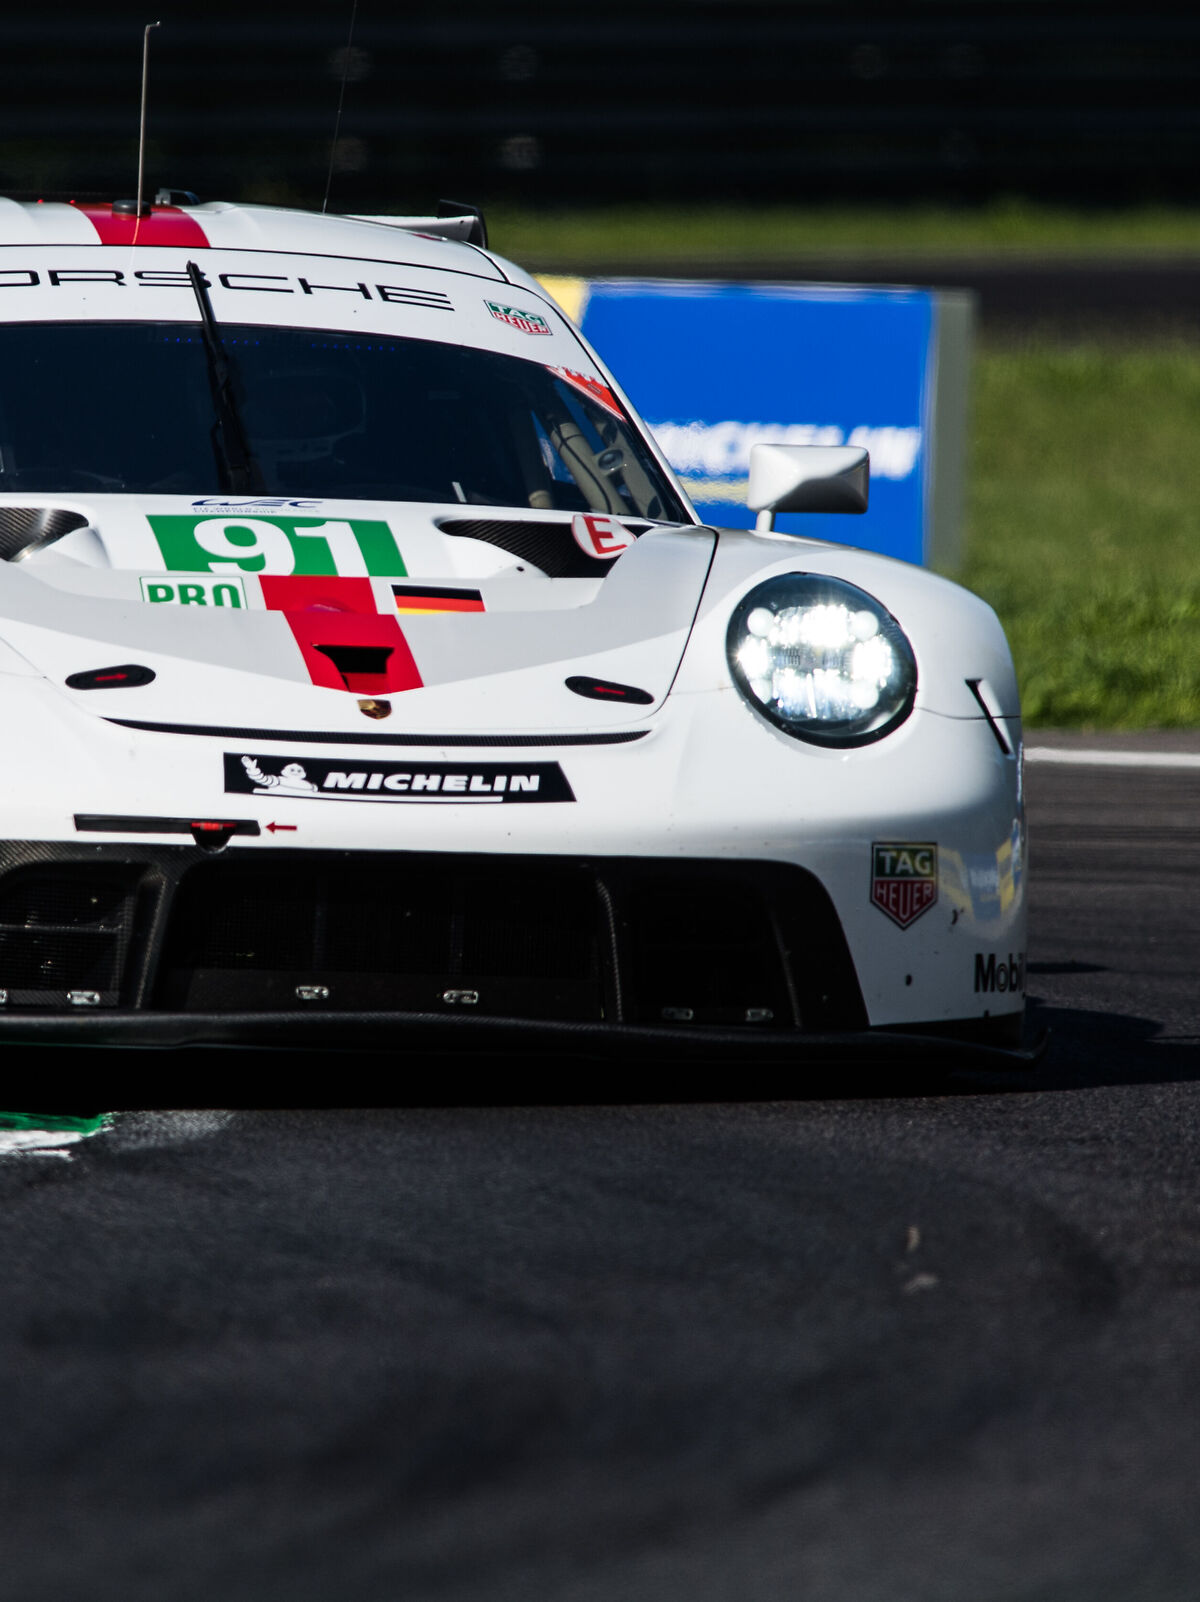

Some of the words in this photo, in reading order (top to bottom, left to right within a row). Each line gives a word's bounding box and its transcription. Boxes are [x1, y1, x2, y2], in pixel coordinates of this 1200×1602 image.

[490, 303, 543, 325] TAG
[494, 311, 549, 333] HEUER
[191, 498, 323, 508] WEC
[583, 515, 627, 554] E
[193, 518, 370, 577] 91
[147, 583, 241, 608] PRO
[322, 772, 540, 792] MICHELIN
[878, 851, 931, 875] TAG
[876, 881, 932, 920] HEUER
